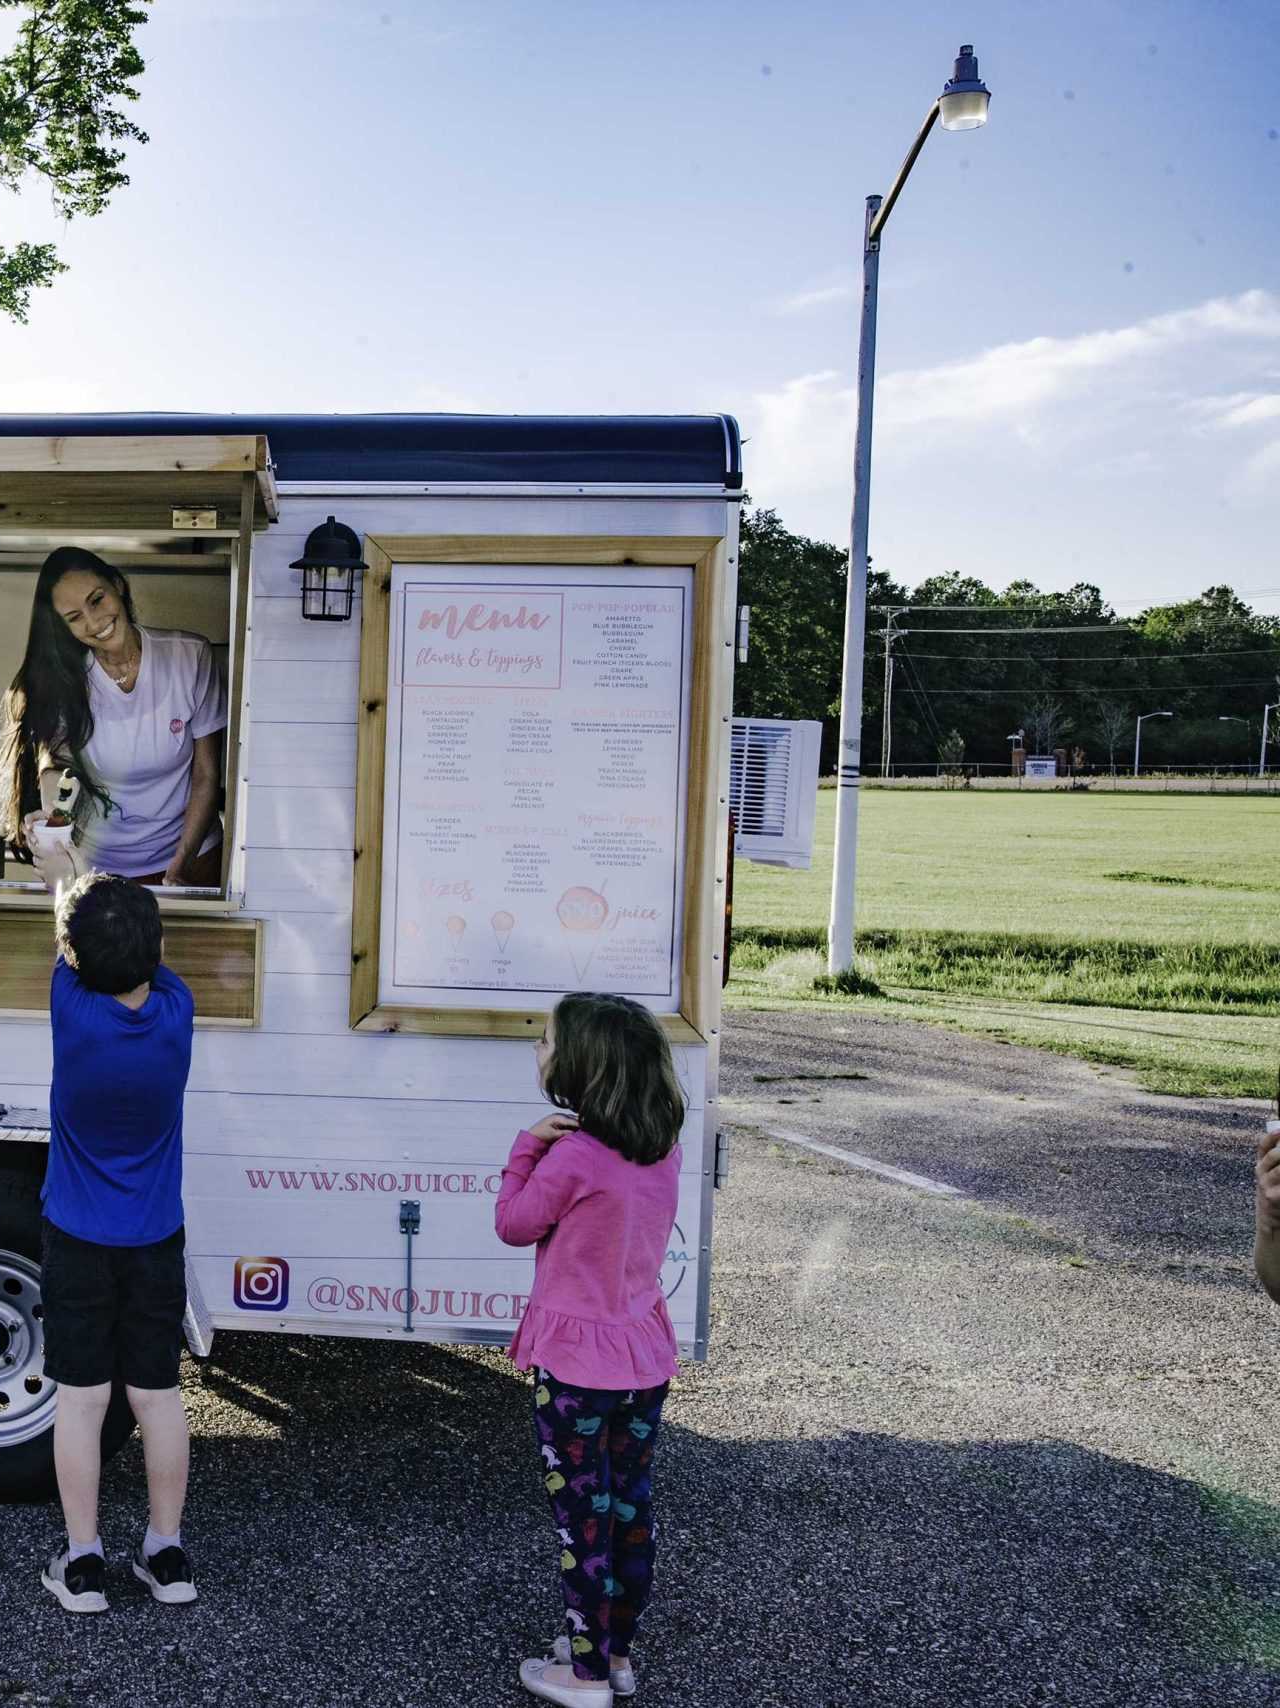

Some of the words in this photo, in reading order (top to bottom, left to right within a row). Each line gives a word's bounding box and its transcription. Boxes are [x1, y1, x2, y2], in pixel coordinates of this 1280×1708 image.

[417, 603, 550, 640] menu
[416, 647, 464, 668] flavors
[468, 648, 481, 667] &
[487, 648, 544, 673] toppings
